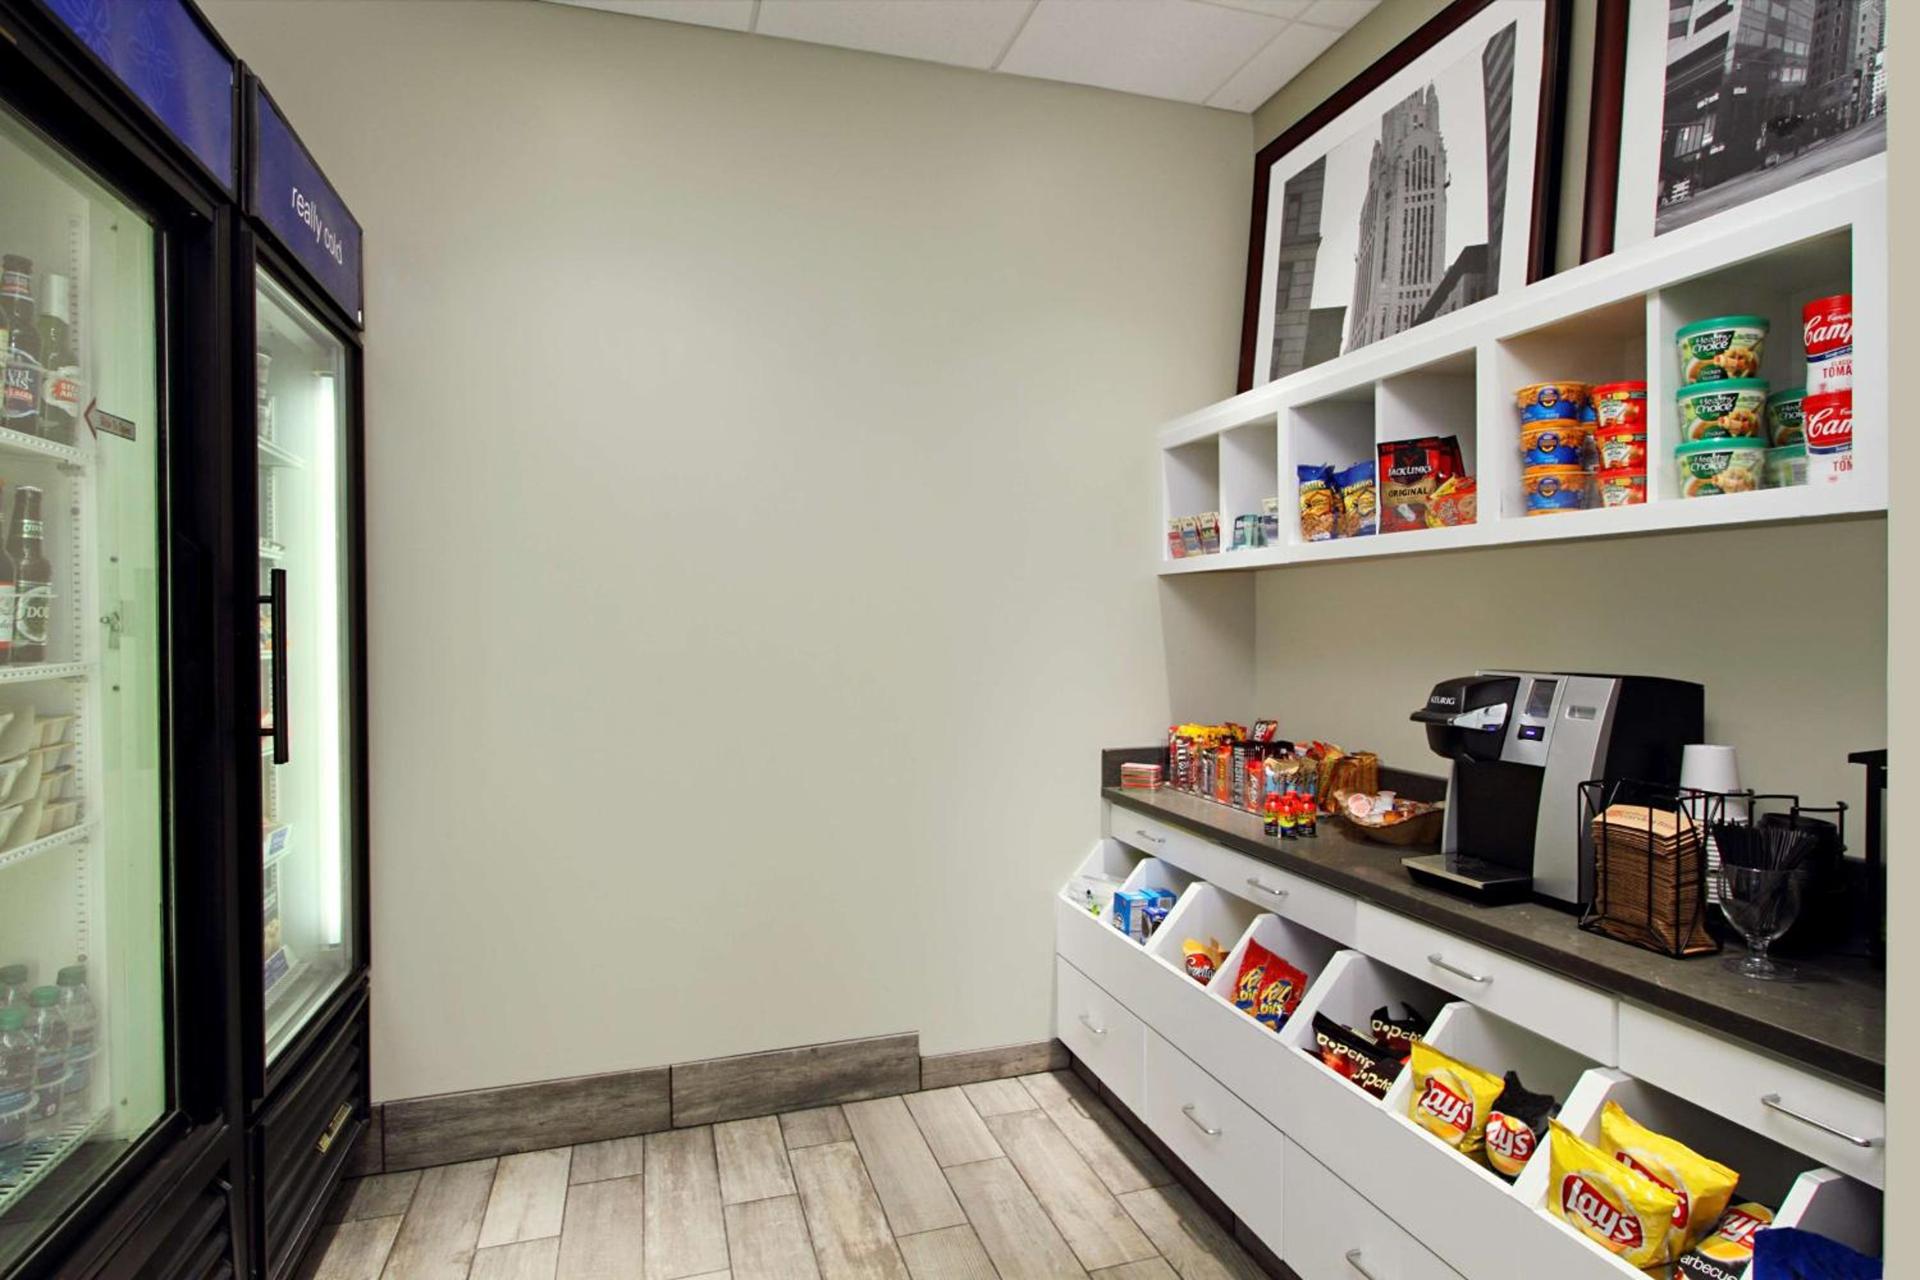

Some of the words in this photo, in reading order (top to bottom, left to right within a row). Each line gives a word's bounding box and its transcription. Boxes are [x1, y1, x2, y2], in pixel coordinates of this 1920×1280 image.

[292, 187, 322, 244] really
[323, 227, 342, 265] cold
[1695, 333, 1732, 345] Healthy
[1692, 341, 1728, 353] Choice
[1823, 365, 1853, 378] TOMA
[1699, 395, 1735, 407] Healthy
[1695, 403, 1733, 414] Choice
[1694, 453, 1729, 465] Healthy
[1388, 466, 1407, 477] JACK
[1690, 462, 1727, 472] Choice
[1388, 486, 1427, 498] ORIGINAL
[1430, 696, 1456, 706] KEURIG
[1566, 1178, 1637, 1241] Lay's
[1680, 1253, 1738, 1280] arbecue
